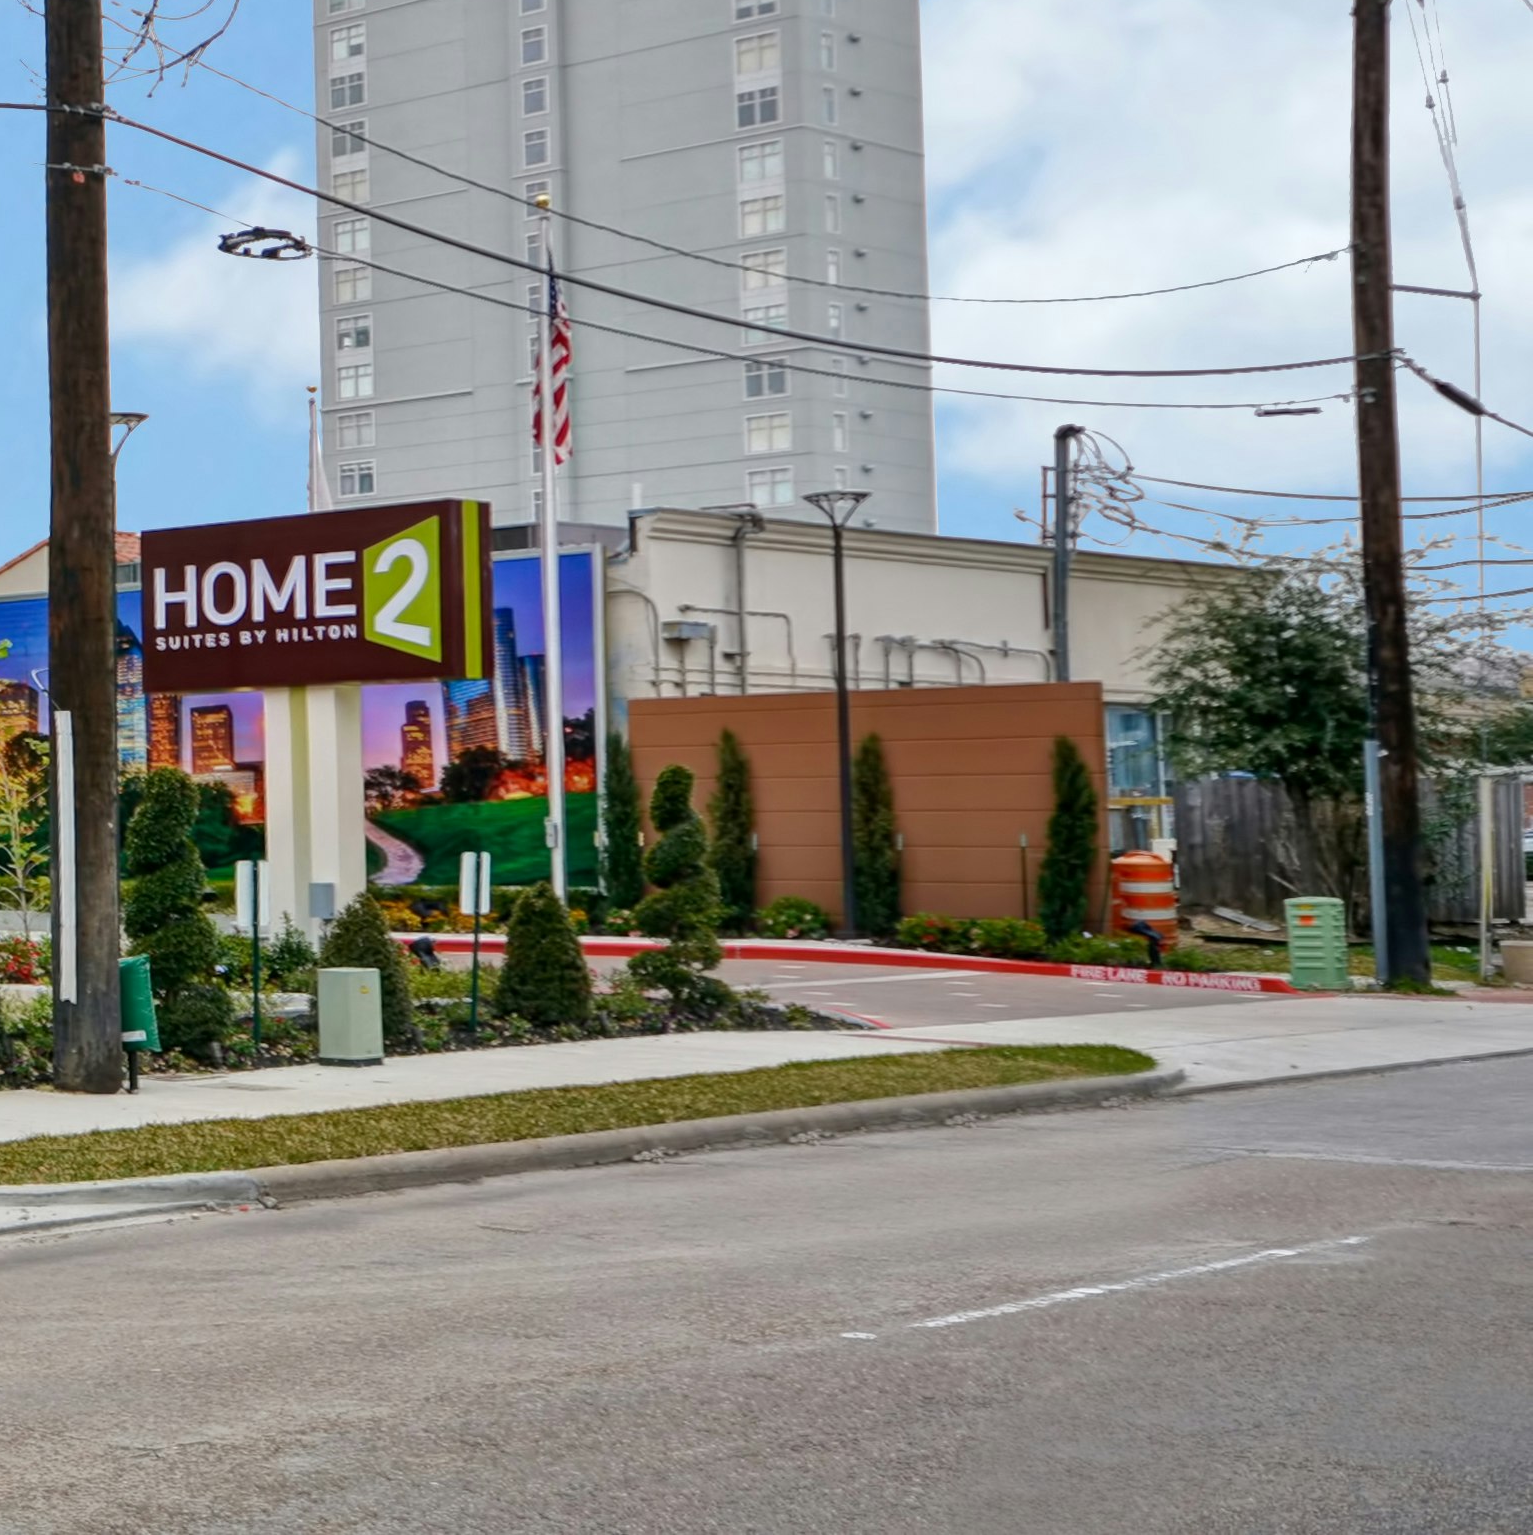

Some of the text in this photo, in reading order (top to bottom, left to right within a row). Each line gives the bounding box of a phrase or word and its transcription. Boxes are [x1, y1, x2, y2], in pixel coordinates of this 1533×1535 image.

[153, 537, 432, 648] HOME 2
[155, 624, 358, 652] SUITES BY HILTON
[1071, 965, 1261, 991] FIRE LANE NO PARKING
